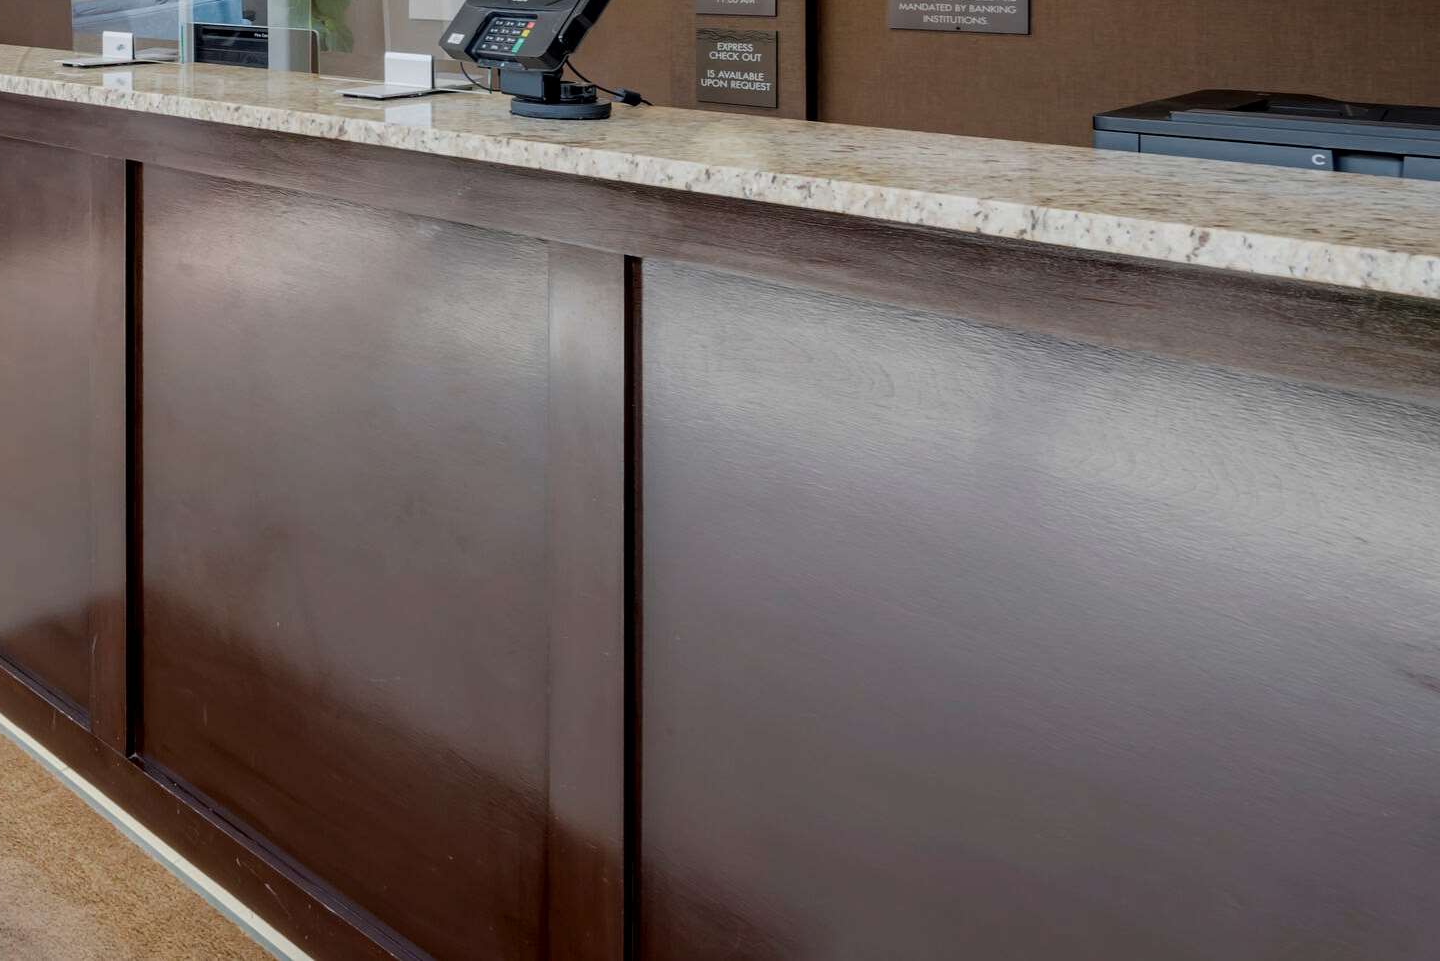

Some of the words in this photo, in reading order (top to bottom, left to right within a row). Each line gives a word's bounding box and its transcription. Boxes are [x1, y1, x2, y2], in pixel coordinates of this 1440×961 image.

[899, 3, 952, 11] MANDATED
[969, 5, 1016, 14] BANKING
[717, 43, 753, 52] EXPRESS
[709, 52, 739, 61] CHECK
[742, 53, 762, 62] OUT
[707, 70, 715, 78] IS
[718, 71, 764, 81] AVAILABLE
[701, 78, 728, 88] UPON
[731, 80, 771, 91] REQUEST
